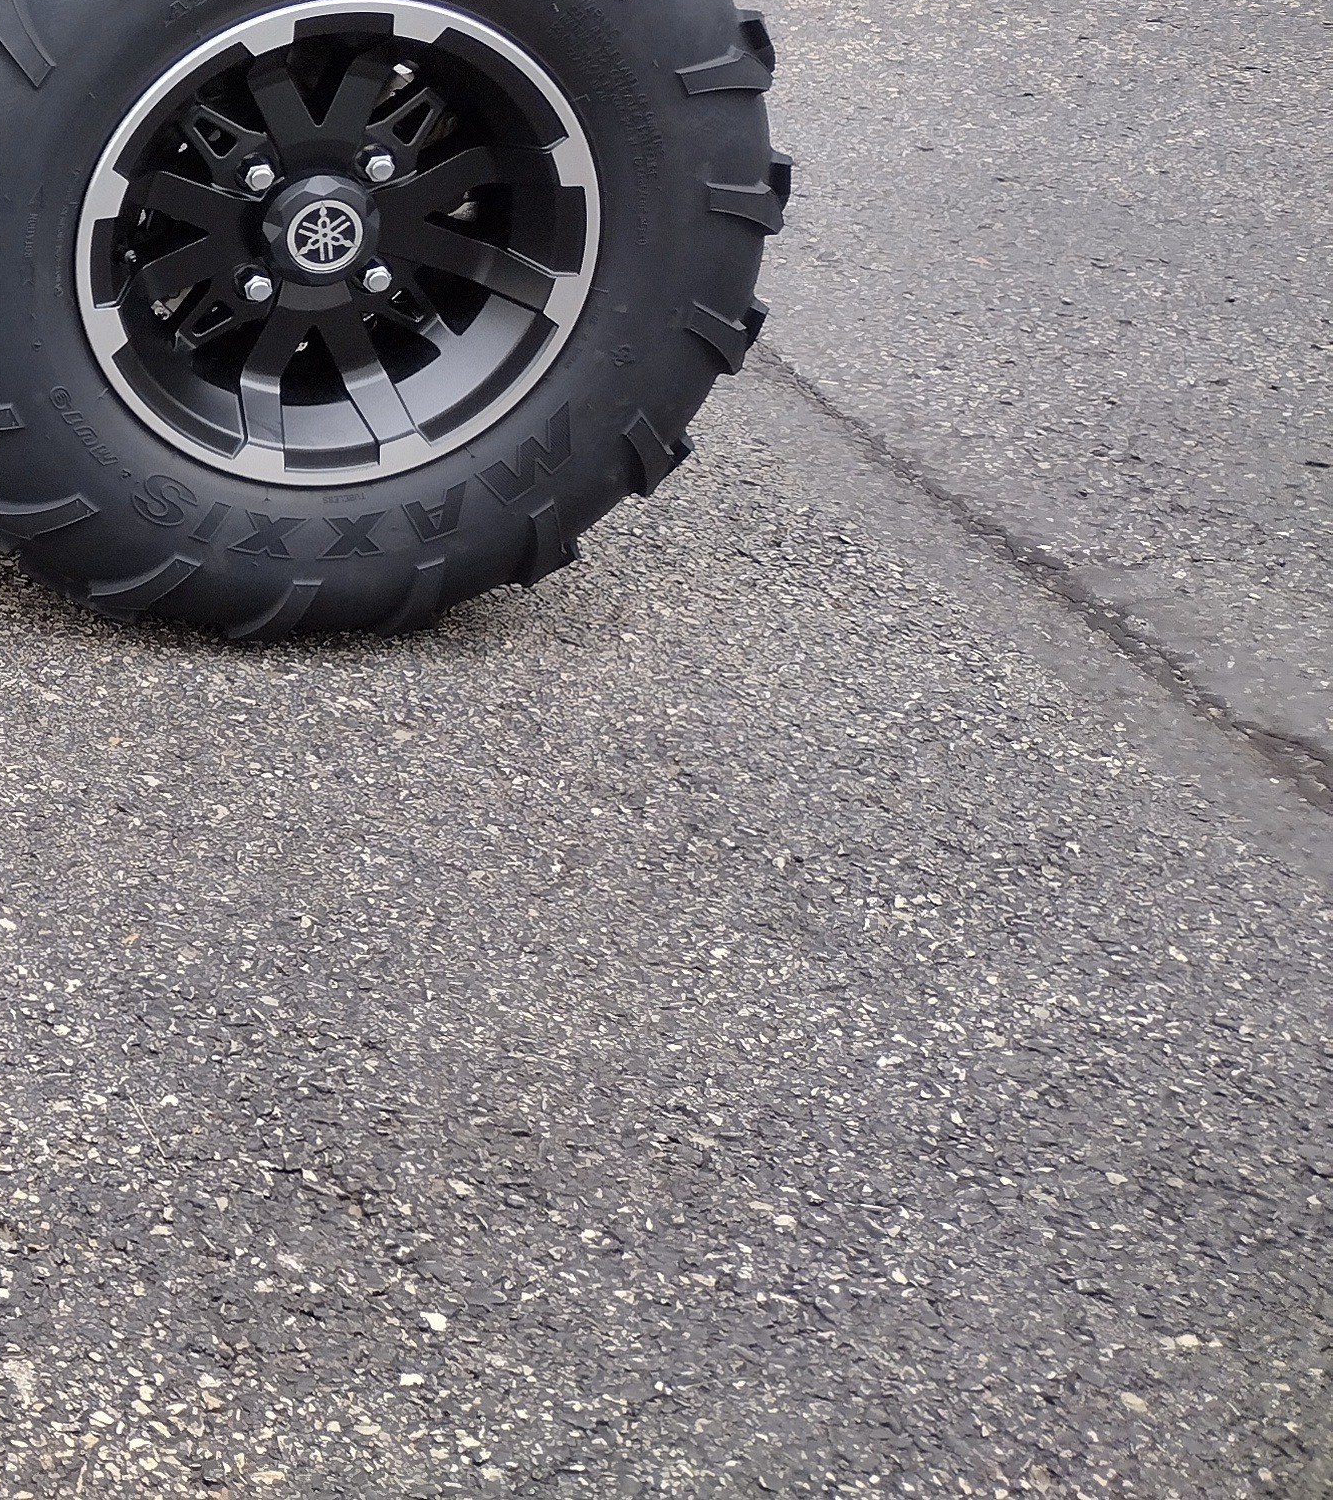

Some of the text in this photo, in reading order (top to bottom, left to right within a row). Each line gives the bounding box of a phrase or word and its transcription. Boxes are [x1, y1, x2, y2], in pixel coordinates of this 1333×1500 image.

[49, 385, 121, 468] MU19
[132, 400, 573, 560] MAXXIS
[322, 491, 367, 504] TUBELESS
